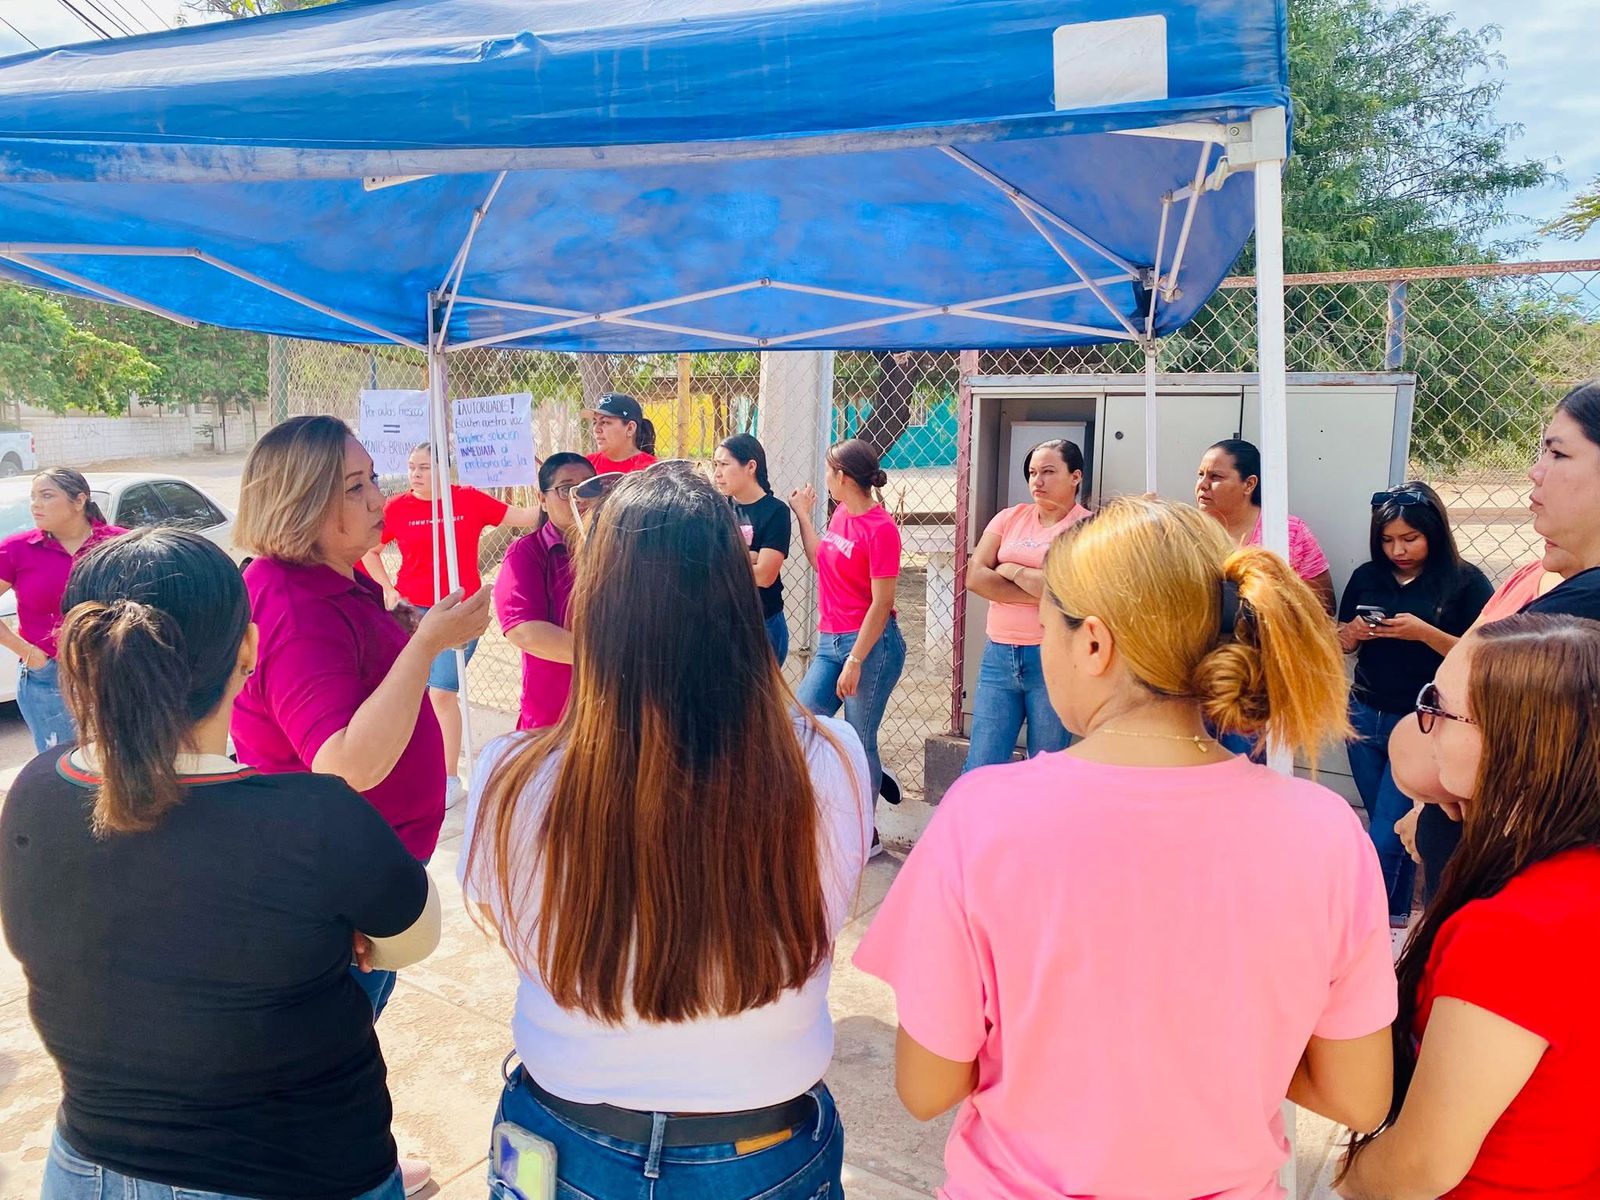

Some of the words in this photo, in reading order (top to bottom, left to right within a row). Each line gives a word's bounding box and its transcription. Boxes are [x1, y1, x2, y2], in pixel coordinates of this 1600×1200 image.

[510, 417, 523, 426] voz
[460, 445, 496, 457] INMEDIATA
[517, 454, 527, 466] la
